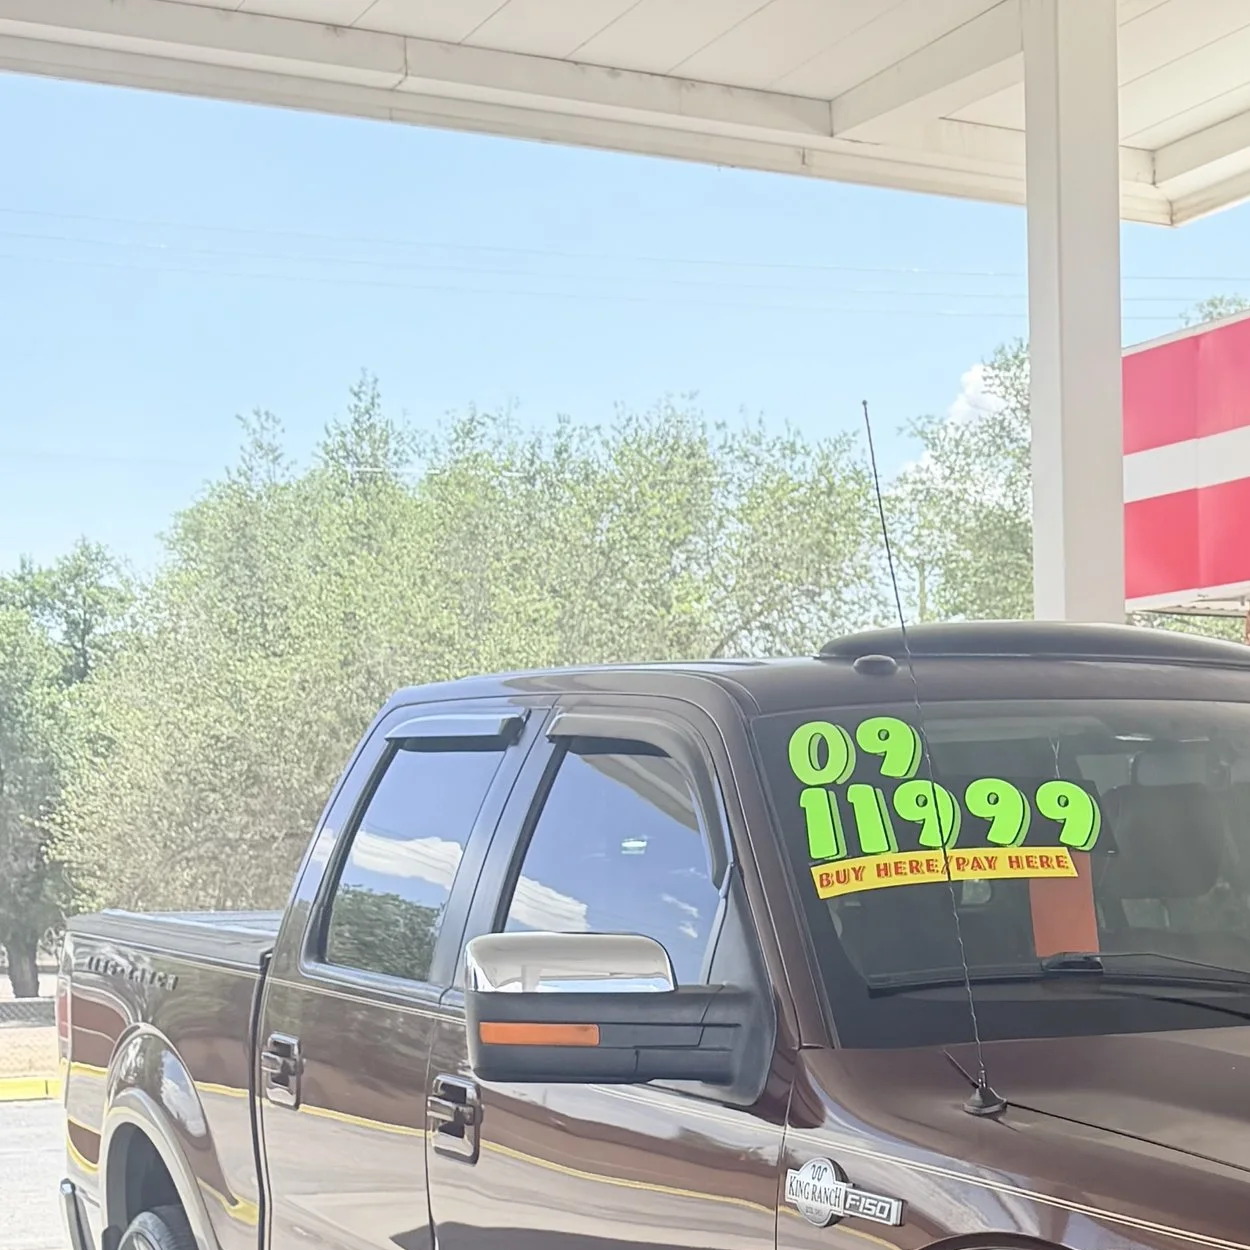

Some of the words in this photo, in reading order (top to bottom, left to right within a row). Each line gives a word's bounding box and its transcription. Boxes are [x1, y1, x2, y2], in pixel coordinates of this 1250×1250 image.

[788, 716, 923, 786] 09
[799, 778, 1102, 860] 11999
[819, 864, 866, 888] BUY
[1007, 854, 1070, 870] HERE
[788, 1175, 810, 1200] KING
[811, 1183, 842, 1208] RANCH
